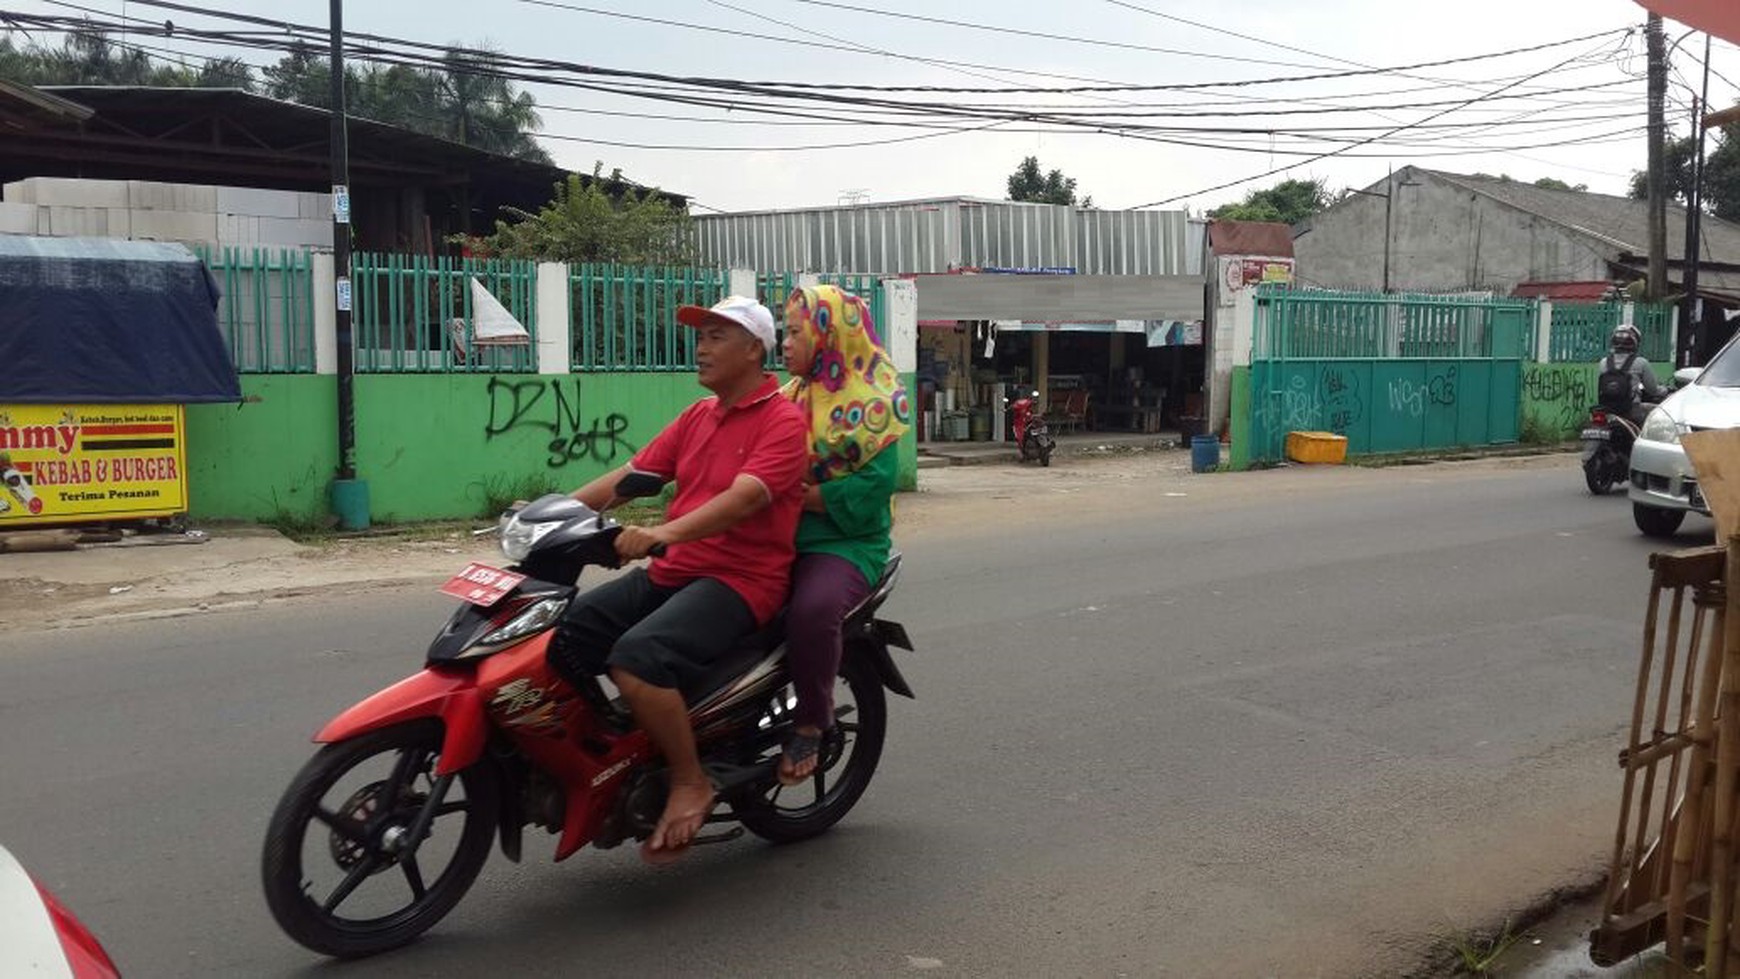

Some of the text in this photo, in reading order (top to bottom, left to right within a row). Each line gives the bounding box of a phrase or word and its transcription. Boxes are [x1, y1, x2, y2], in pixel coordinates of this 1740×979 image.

[35, 456, 177, 485] KEBAB & BURGER
[59, 489, 160, 501] Terima Pesanan
